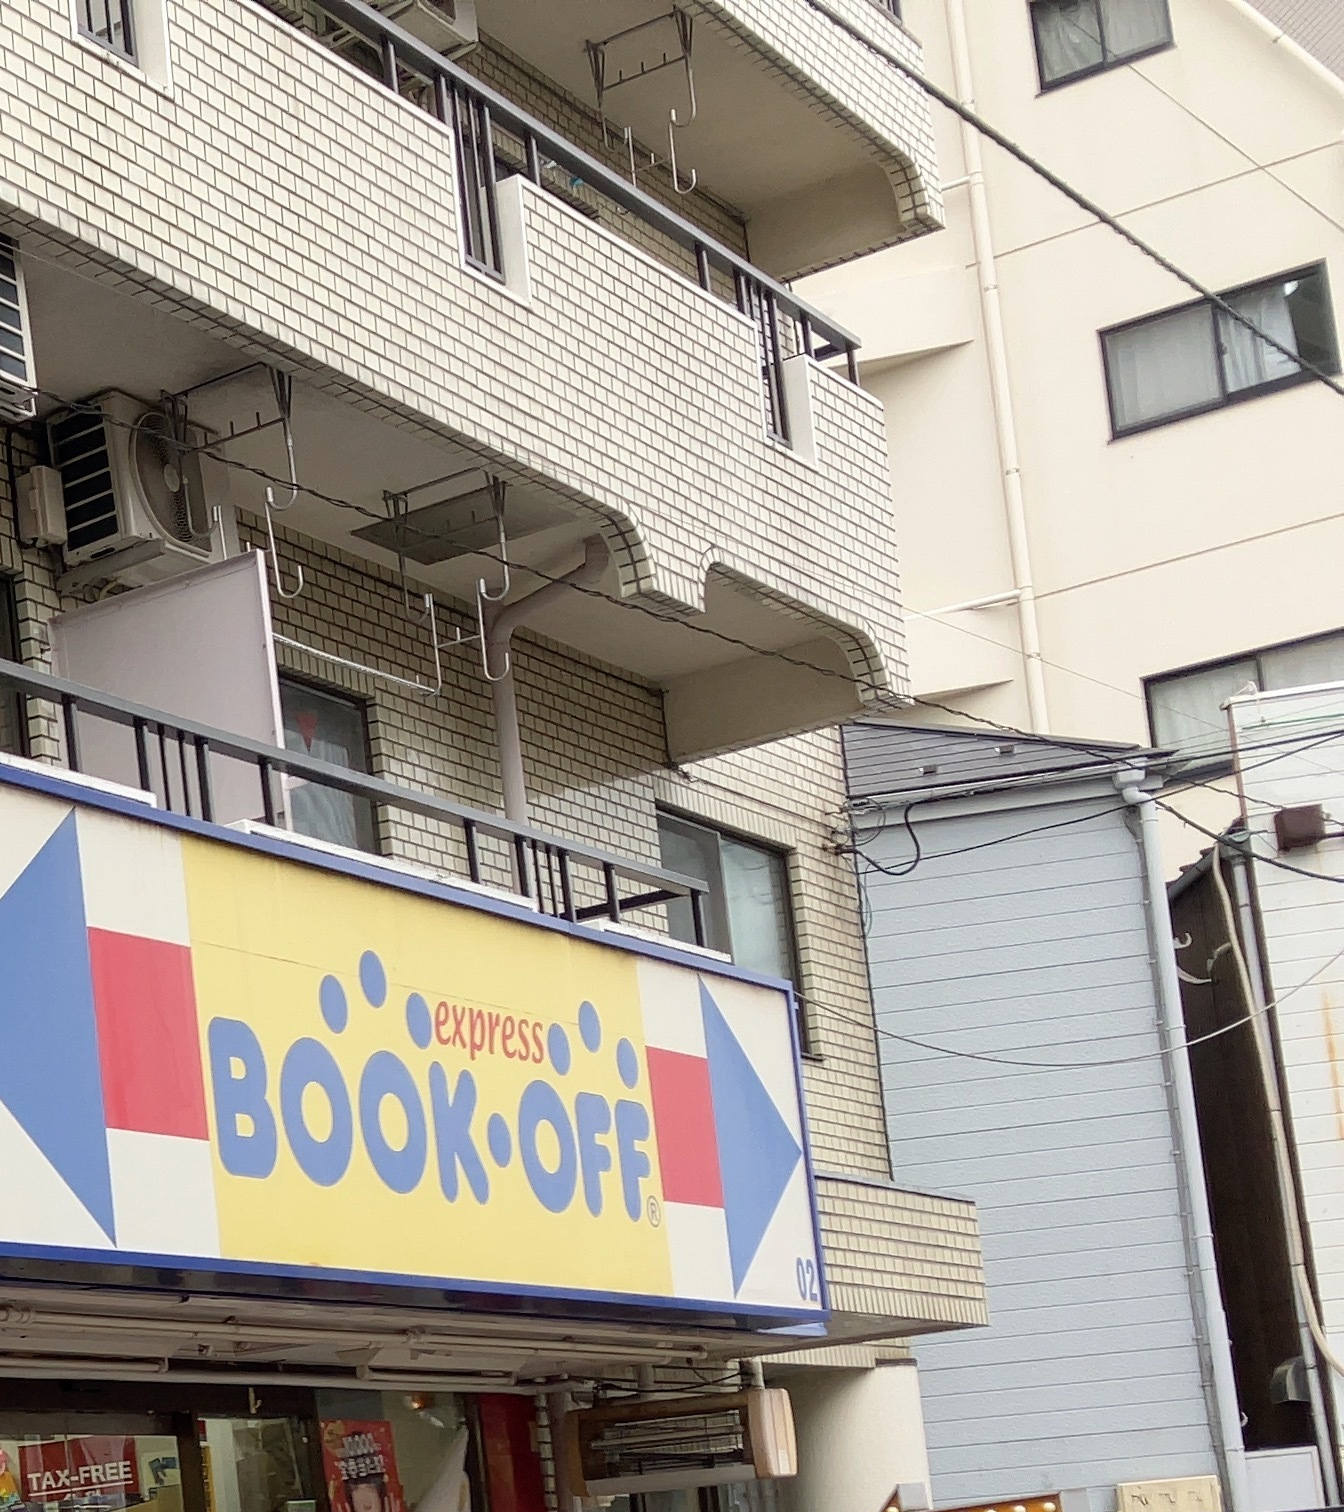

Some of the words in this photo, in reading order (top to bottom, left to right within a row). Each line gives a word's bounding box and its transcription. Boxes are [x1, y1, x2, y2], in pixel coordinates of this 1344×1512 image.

[434, 999, 545, 1064] express
[795, 1256, 818, 1303] 02
[26, 1460, 133, 1491] TAX-FREE
